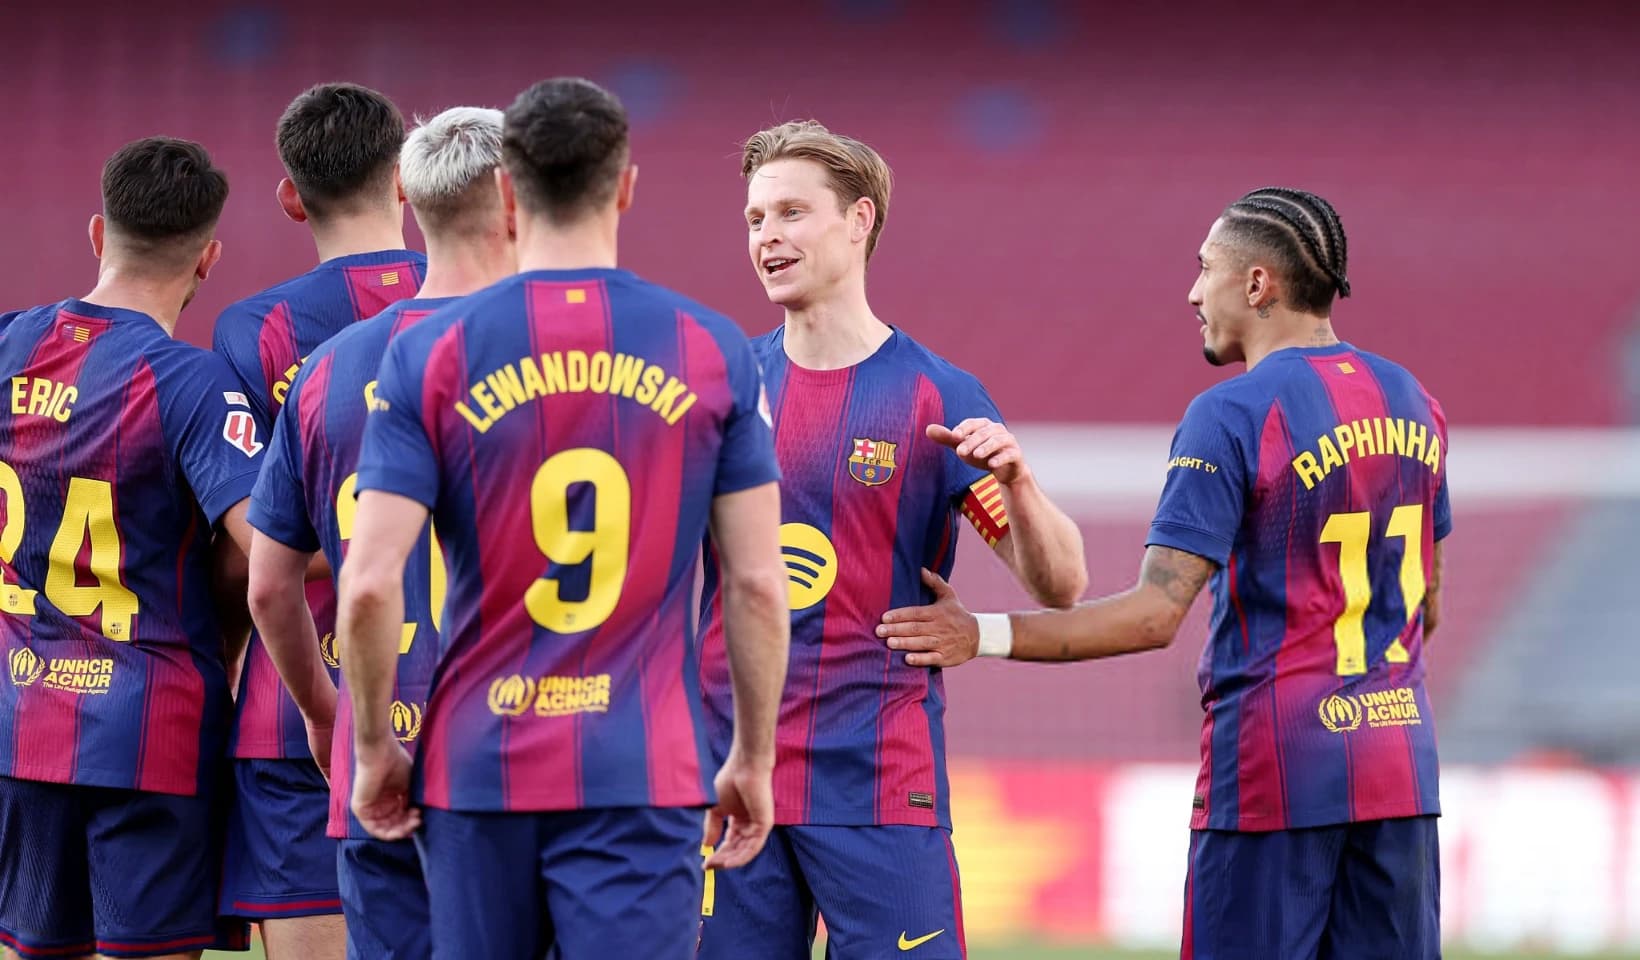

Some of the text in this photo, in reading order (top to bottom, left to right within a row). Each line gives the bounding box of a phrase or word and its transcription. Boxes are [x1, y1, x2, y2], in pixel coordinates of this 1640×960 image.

[11, 376, 78, 423] ERIC
[454, 350, 698, 434] LEWANDOWSKI
[1292, 417, 1440, 490] RAPHINHA
[524, 448, 631, 634] 9
[1320, 504, 1424, 676] 11
[49, 658, 114, 674] UNHCR
[43, 671, 112, 688] ACNUR
[538, 674, 612, 694] UNHCR
[534, 690, 610, 710] ACNUR
[1359, 687, 1415, 707] UNHCR
[1367, 702, 1420, 722] ACNUR
